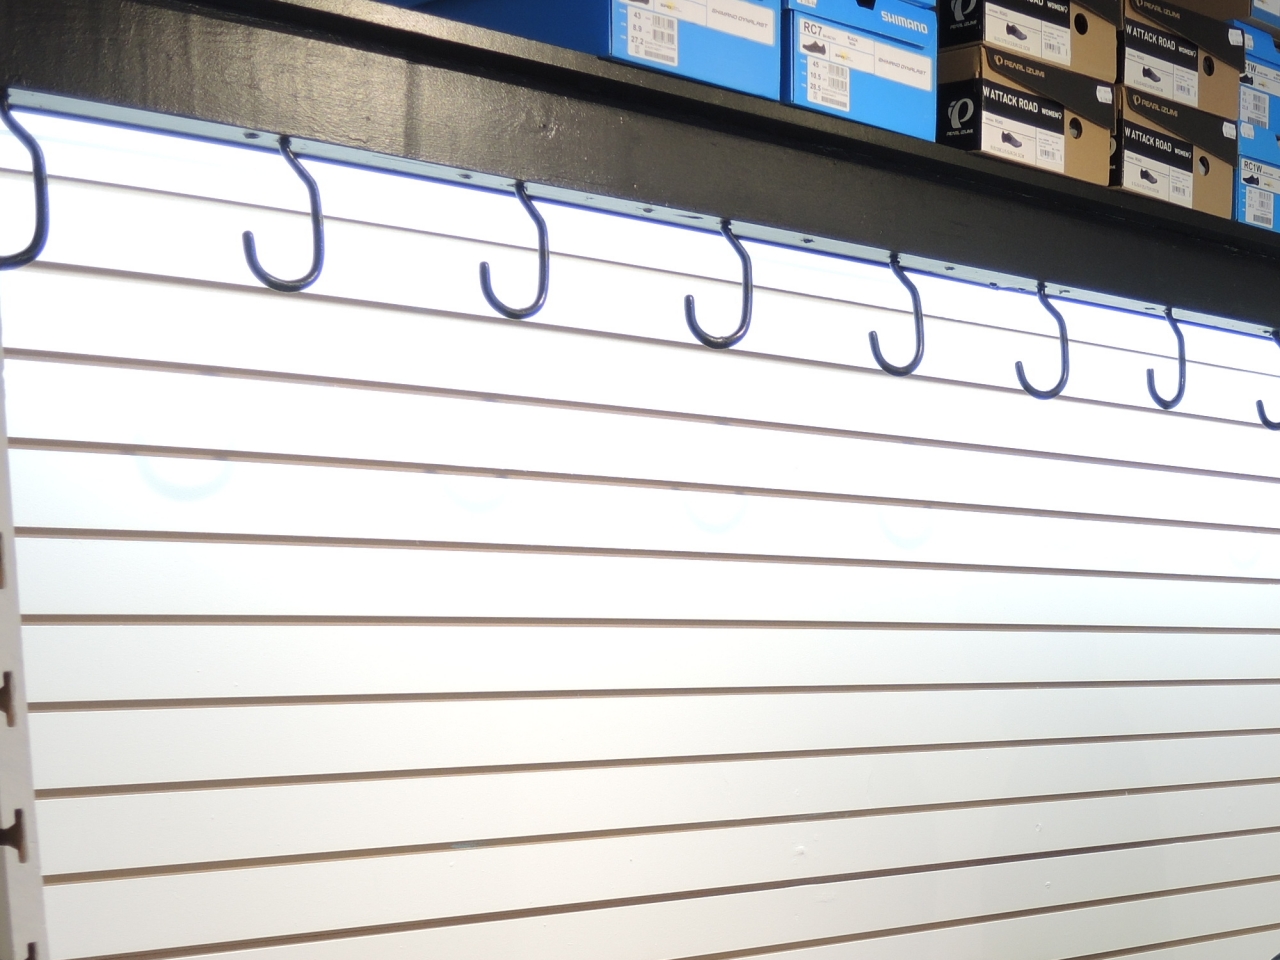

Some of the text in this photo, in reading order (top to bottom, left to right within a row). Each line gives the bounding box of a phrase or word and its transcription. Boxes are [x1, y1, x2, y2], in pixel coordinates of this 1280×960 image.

[633, 12, 641, 20] 43
[881, 10, 928, 34] SHIMANO
[632, 24, 643, 32] 8.9
[803, 21, 823, 37] RC7
[630, 35, 644, 46] 27.2
[1125, 24, 1132, 34] W
[1132, 26, 1158, 44] ATTACK
[1158, 36, 1176, 51] ROAD
[812, 60, 820, 68] 45
[1004, 59, 1025, 72] PEARL
[1244, 62, 1257, 73] 1W
[810, 71, 822, 81] 10.5
[810, 82, 821, 92] 28.5
[982, 85, 991, 98] W
[990, 88, 1018, 108] ATTACK
[1018, 98, 1038, 113] ROAD
[1124, 126, 1132, 137] W
[1131, 129, 1155, 147] ATTACK
[1155, 138, 1172, 153] ROAD
[1244, 160, 1262, 173] RC1W
